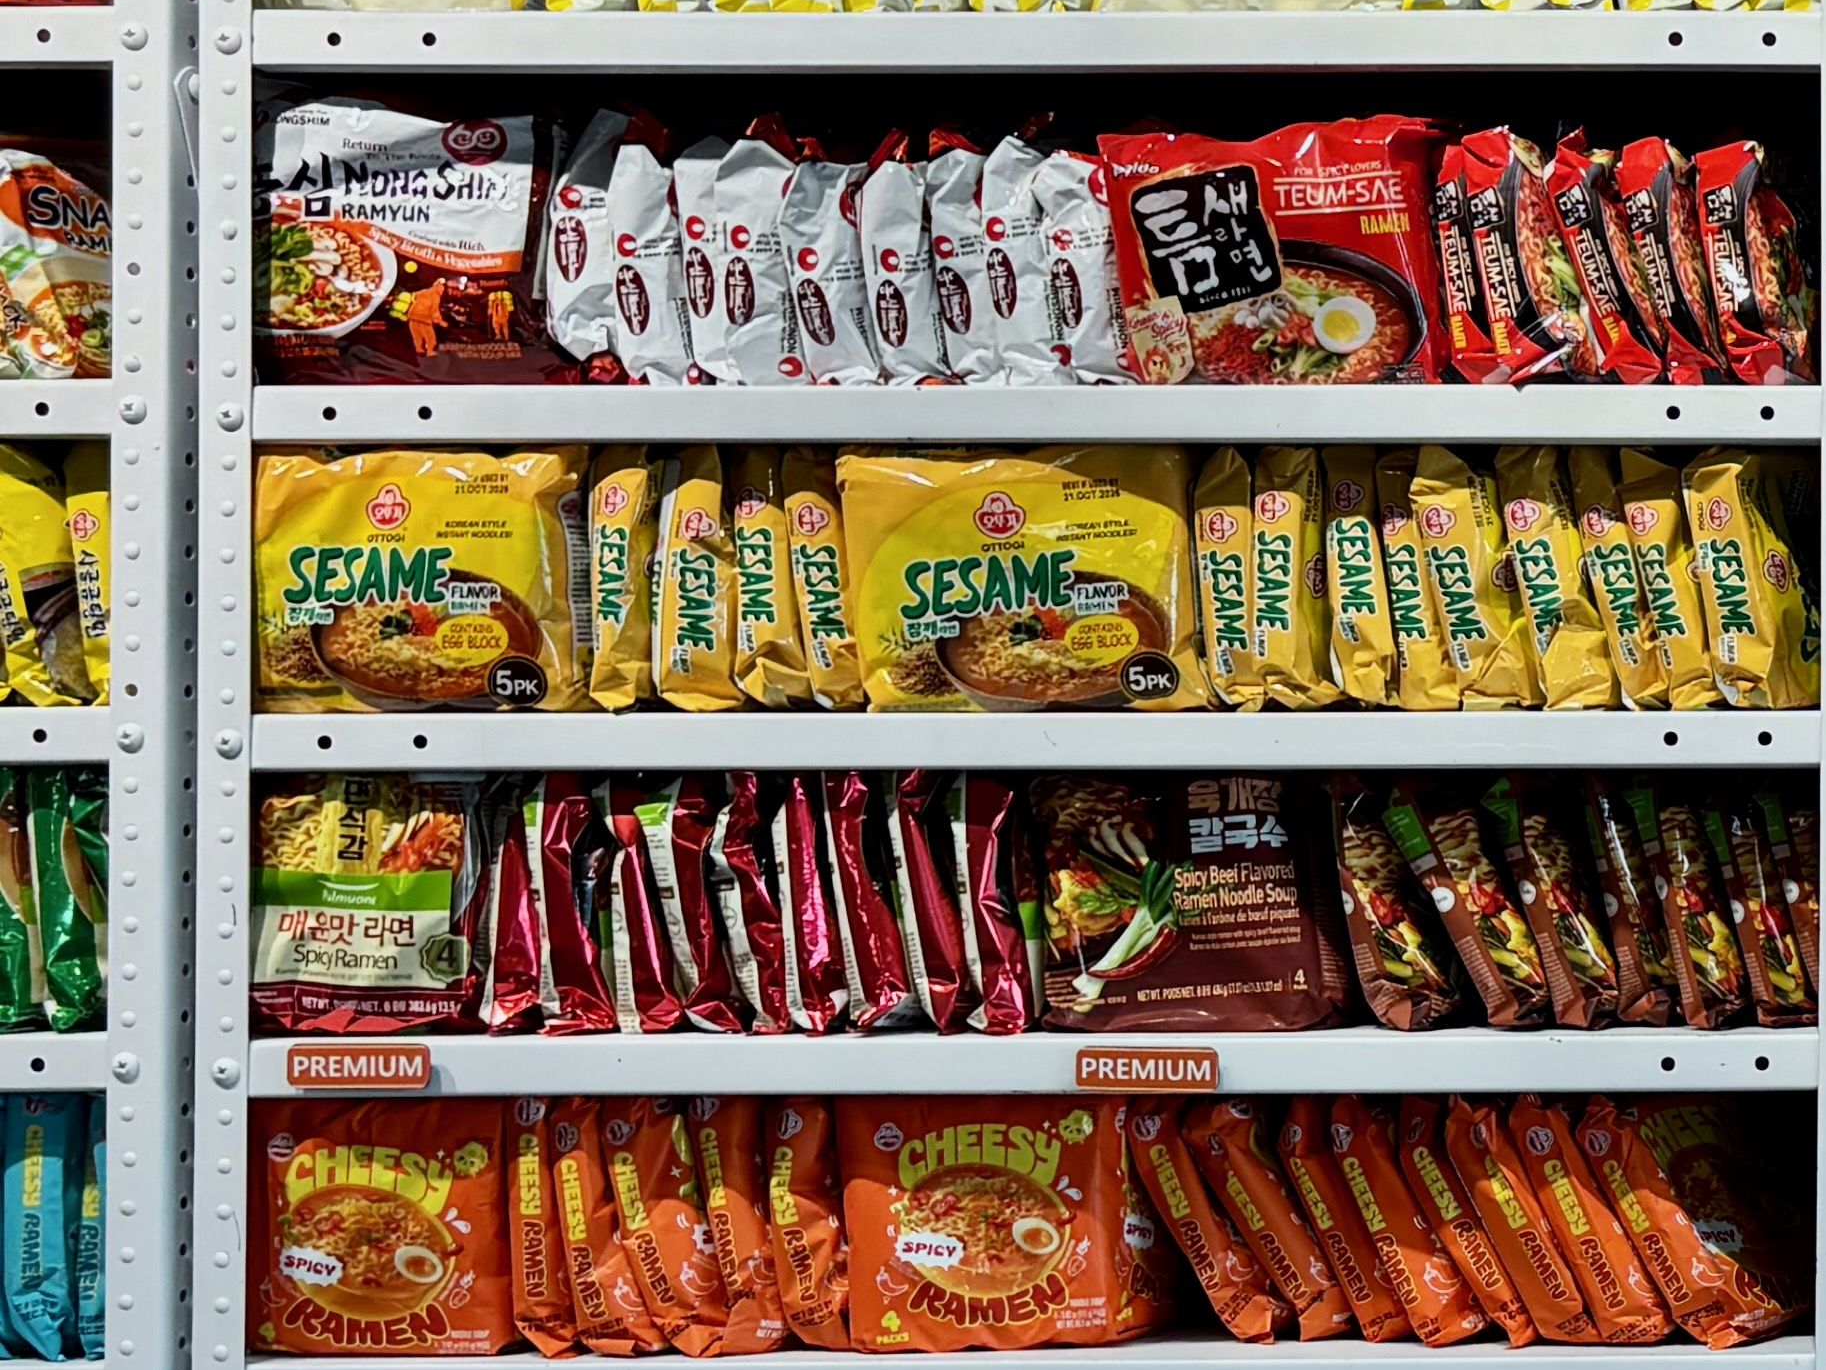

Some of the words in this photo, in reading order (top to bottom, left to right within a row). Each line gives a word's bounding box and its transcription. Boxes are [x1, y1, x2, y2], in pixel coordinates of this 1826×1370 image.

[1272, 178, 1404, 210] TEUM-SAE
[340, 202, 432, 225] RAMYUN
[1359, 213, 1410, 237] RAMEN
[283, 544, 452, 604] SESAME
[1188, 815, 1289, 854] 칼국수
[1174, 864, 1209, 890] Spicy
[1211, 864, 1239, 886] Beef
[1241, 862, 1295, 882] Flavored
[1174, 886, 1216, 909] Ramen
[1218, 885, 1262, 906] Noodle
[1265, 883, 1298, 906] Soup
[277, 912, 356, 948] 매운맛
[362, 911, 417, 948] 라면
[292, 943, 334, 970] Spicy
[334, 947, 399, 971] Ramen
[292, 1054, 425, 1079] PREMIUM
[1079, 1056, 1212, 1083] PREMIUM
[283, 1254, 338, 1277] SPICY
[282, 1302, 452, 1350] RAMEN
